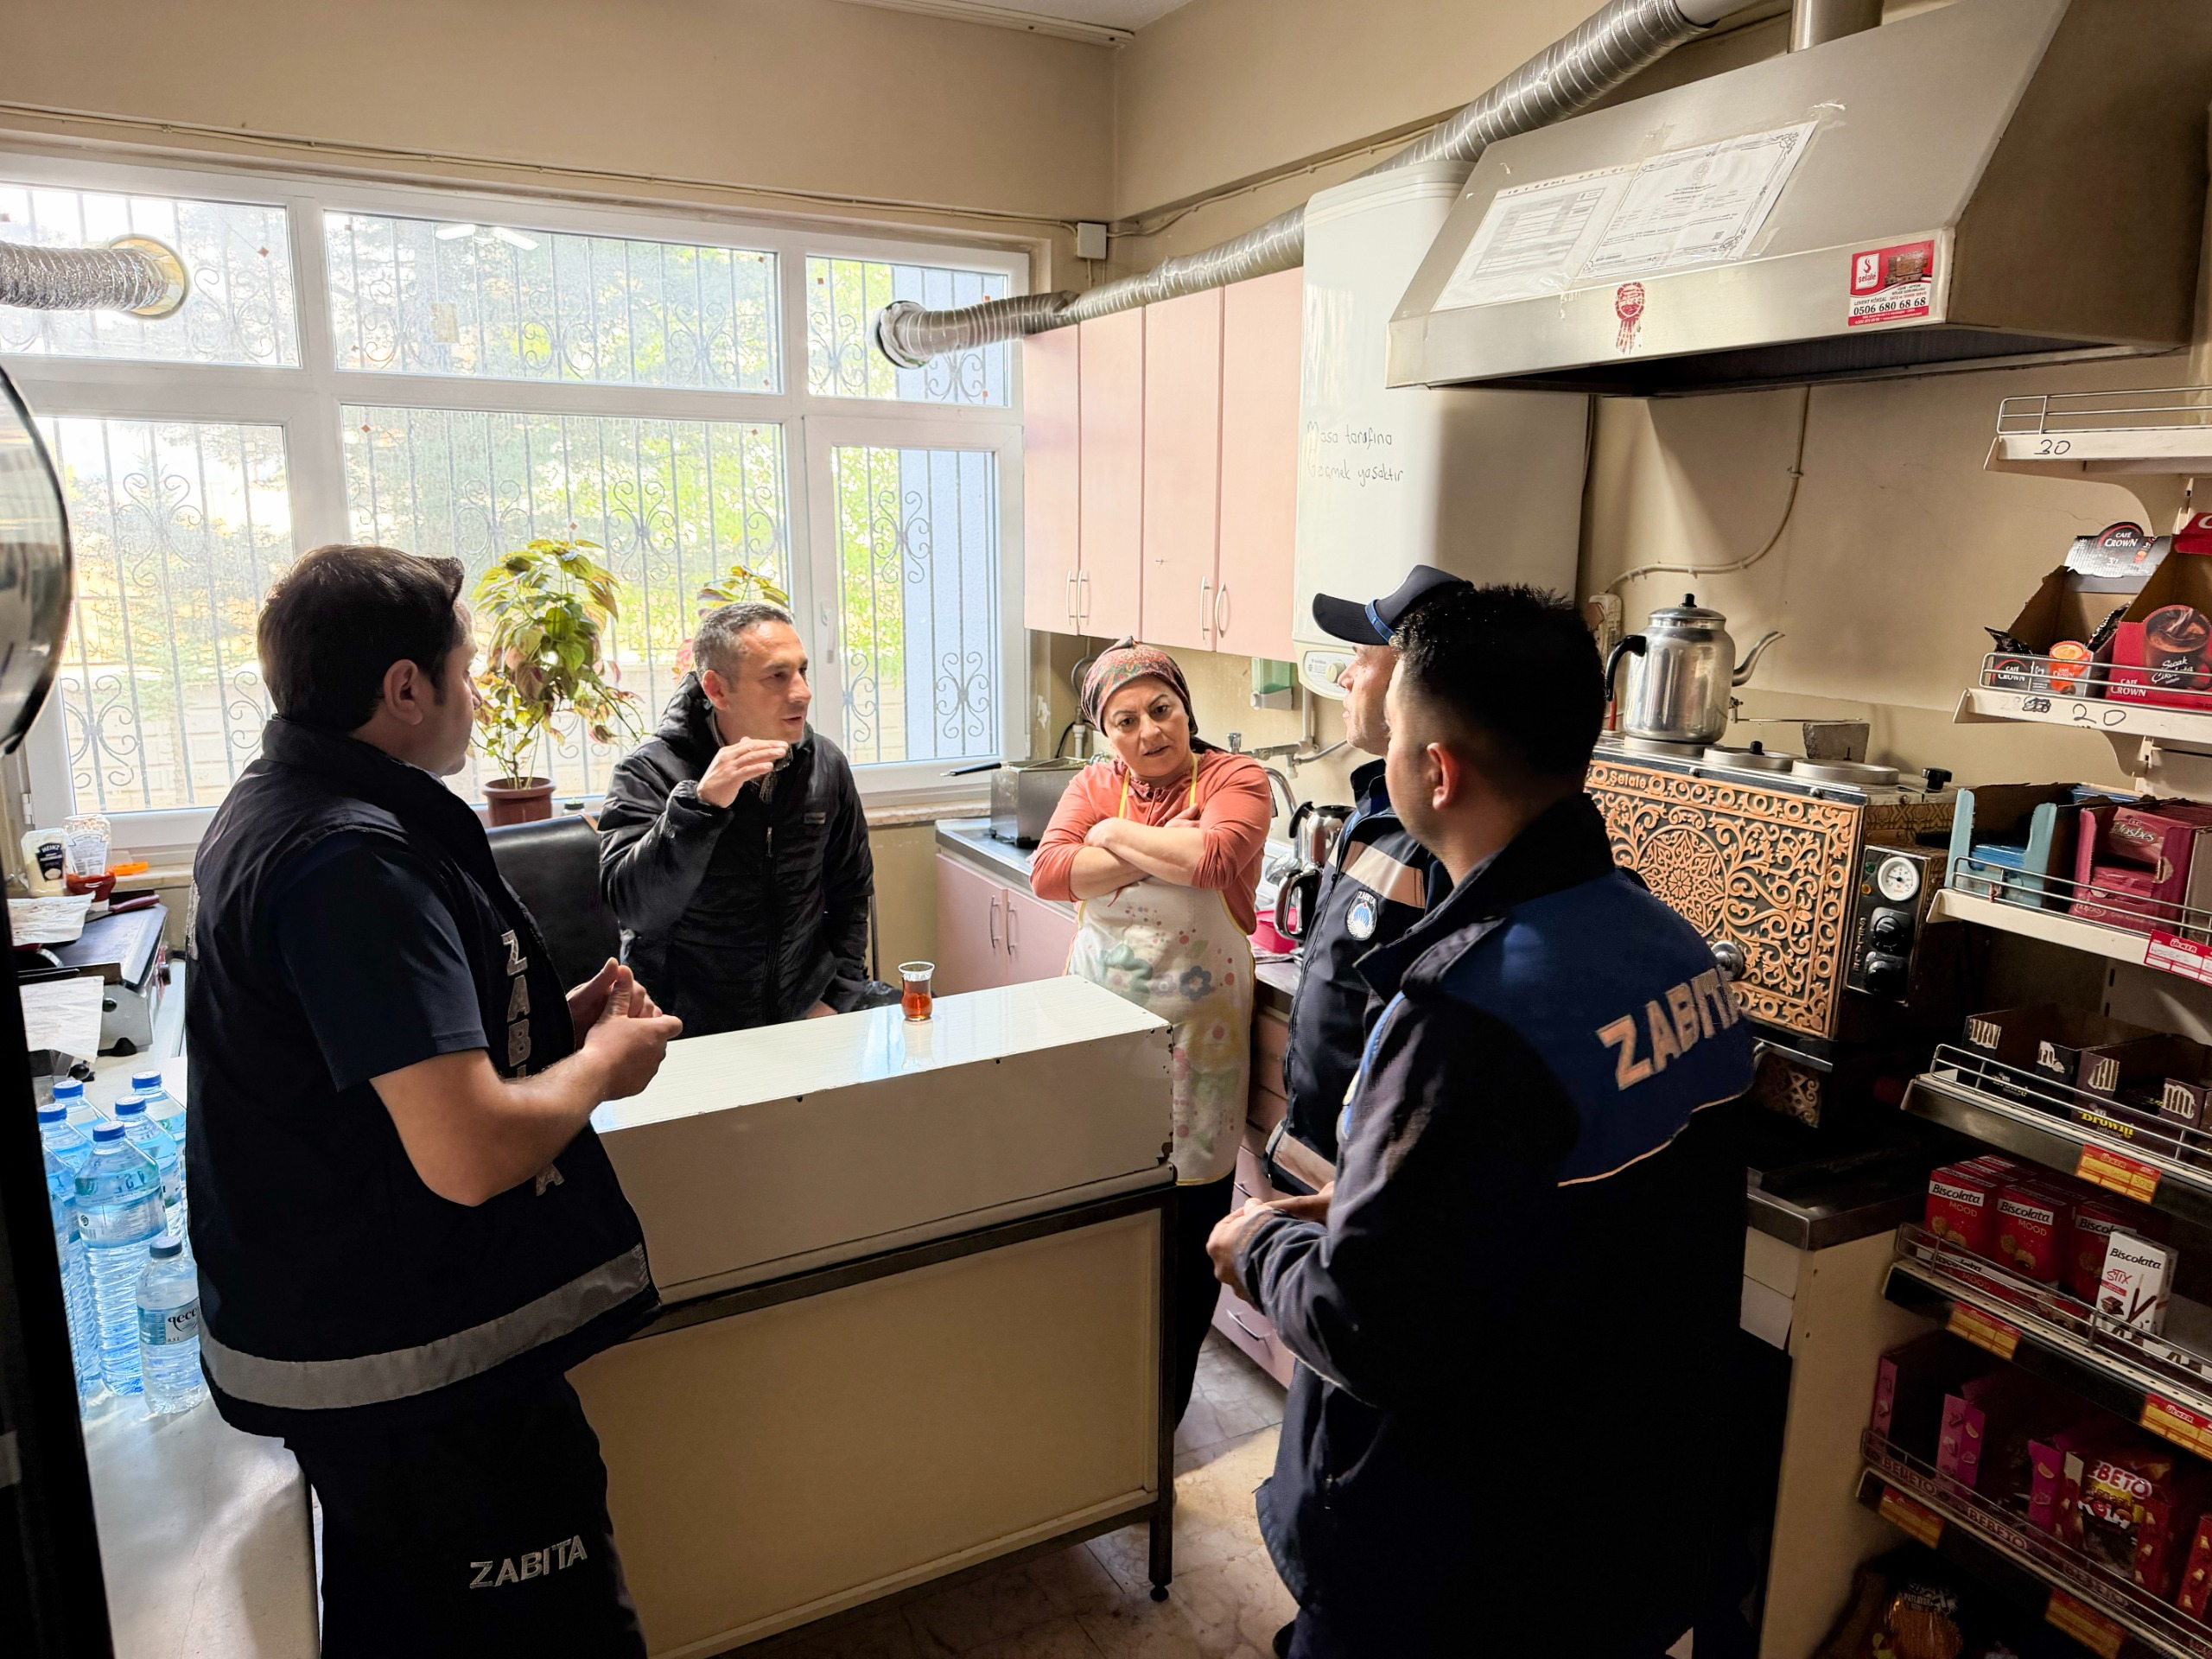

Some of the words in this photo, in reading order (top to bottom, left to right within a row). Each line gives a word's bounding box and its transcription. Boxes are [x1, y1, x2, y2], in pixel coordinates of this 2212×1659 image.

[1853, 304, 1876, 315] 0506
[1878, 302, 1896, 312] 680
[1899, 299, 1910, 308] 68
[1914, 296, 1926, 306] 68
[1307, 421, 1338, 443] Masa
[2104, 538, 2138, 548] CROWN
[1998, 672, 2025, 682] CROWN
[2110, 686, 2146, 697] CROWN
[2072, 702, 2126, 726] 20
[41, 844, 60, 853] HEINZ
[2171, 938, 2196, 953] ÜLKER
[501, 929, 564, 1196] ZABA
[1932, 1184, 1981, 1205] Biscolata
[1948, 1200, 1978, 1217] MOOD
[1999, 1201, 2050, 1223] Biscolata
[2018, 1218, 2048, 1236] MOOD
[2078, 1218, 2117, 1236] Biscol
[2109, 1248, 2162, 1270] Biscolata
[2107, 1268, 2133, 1285] STIX
[2094, 1462, 2152, 1499] BETO
[1968, 1507, 2027, 1549] BEBETO
[469, 1534, 588, 1589] ZABITA
